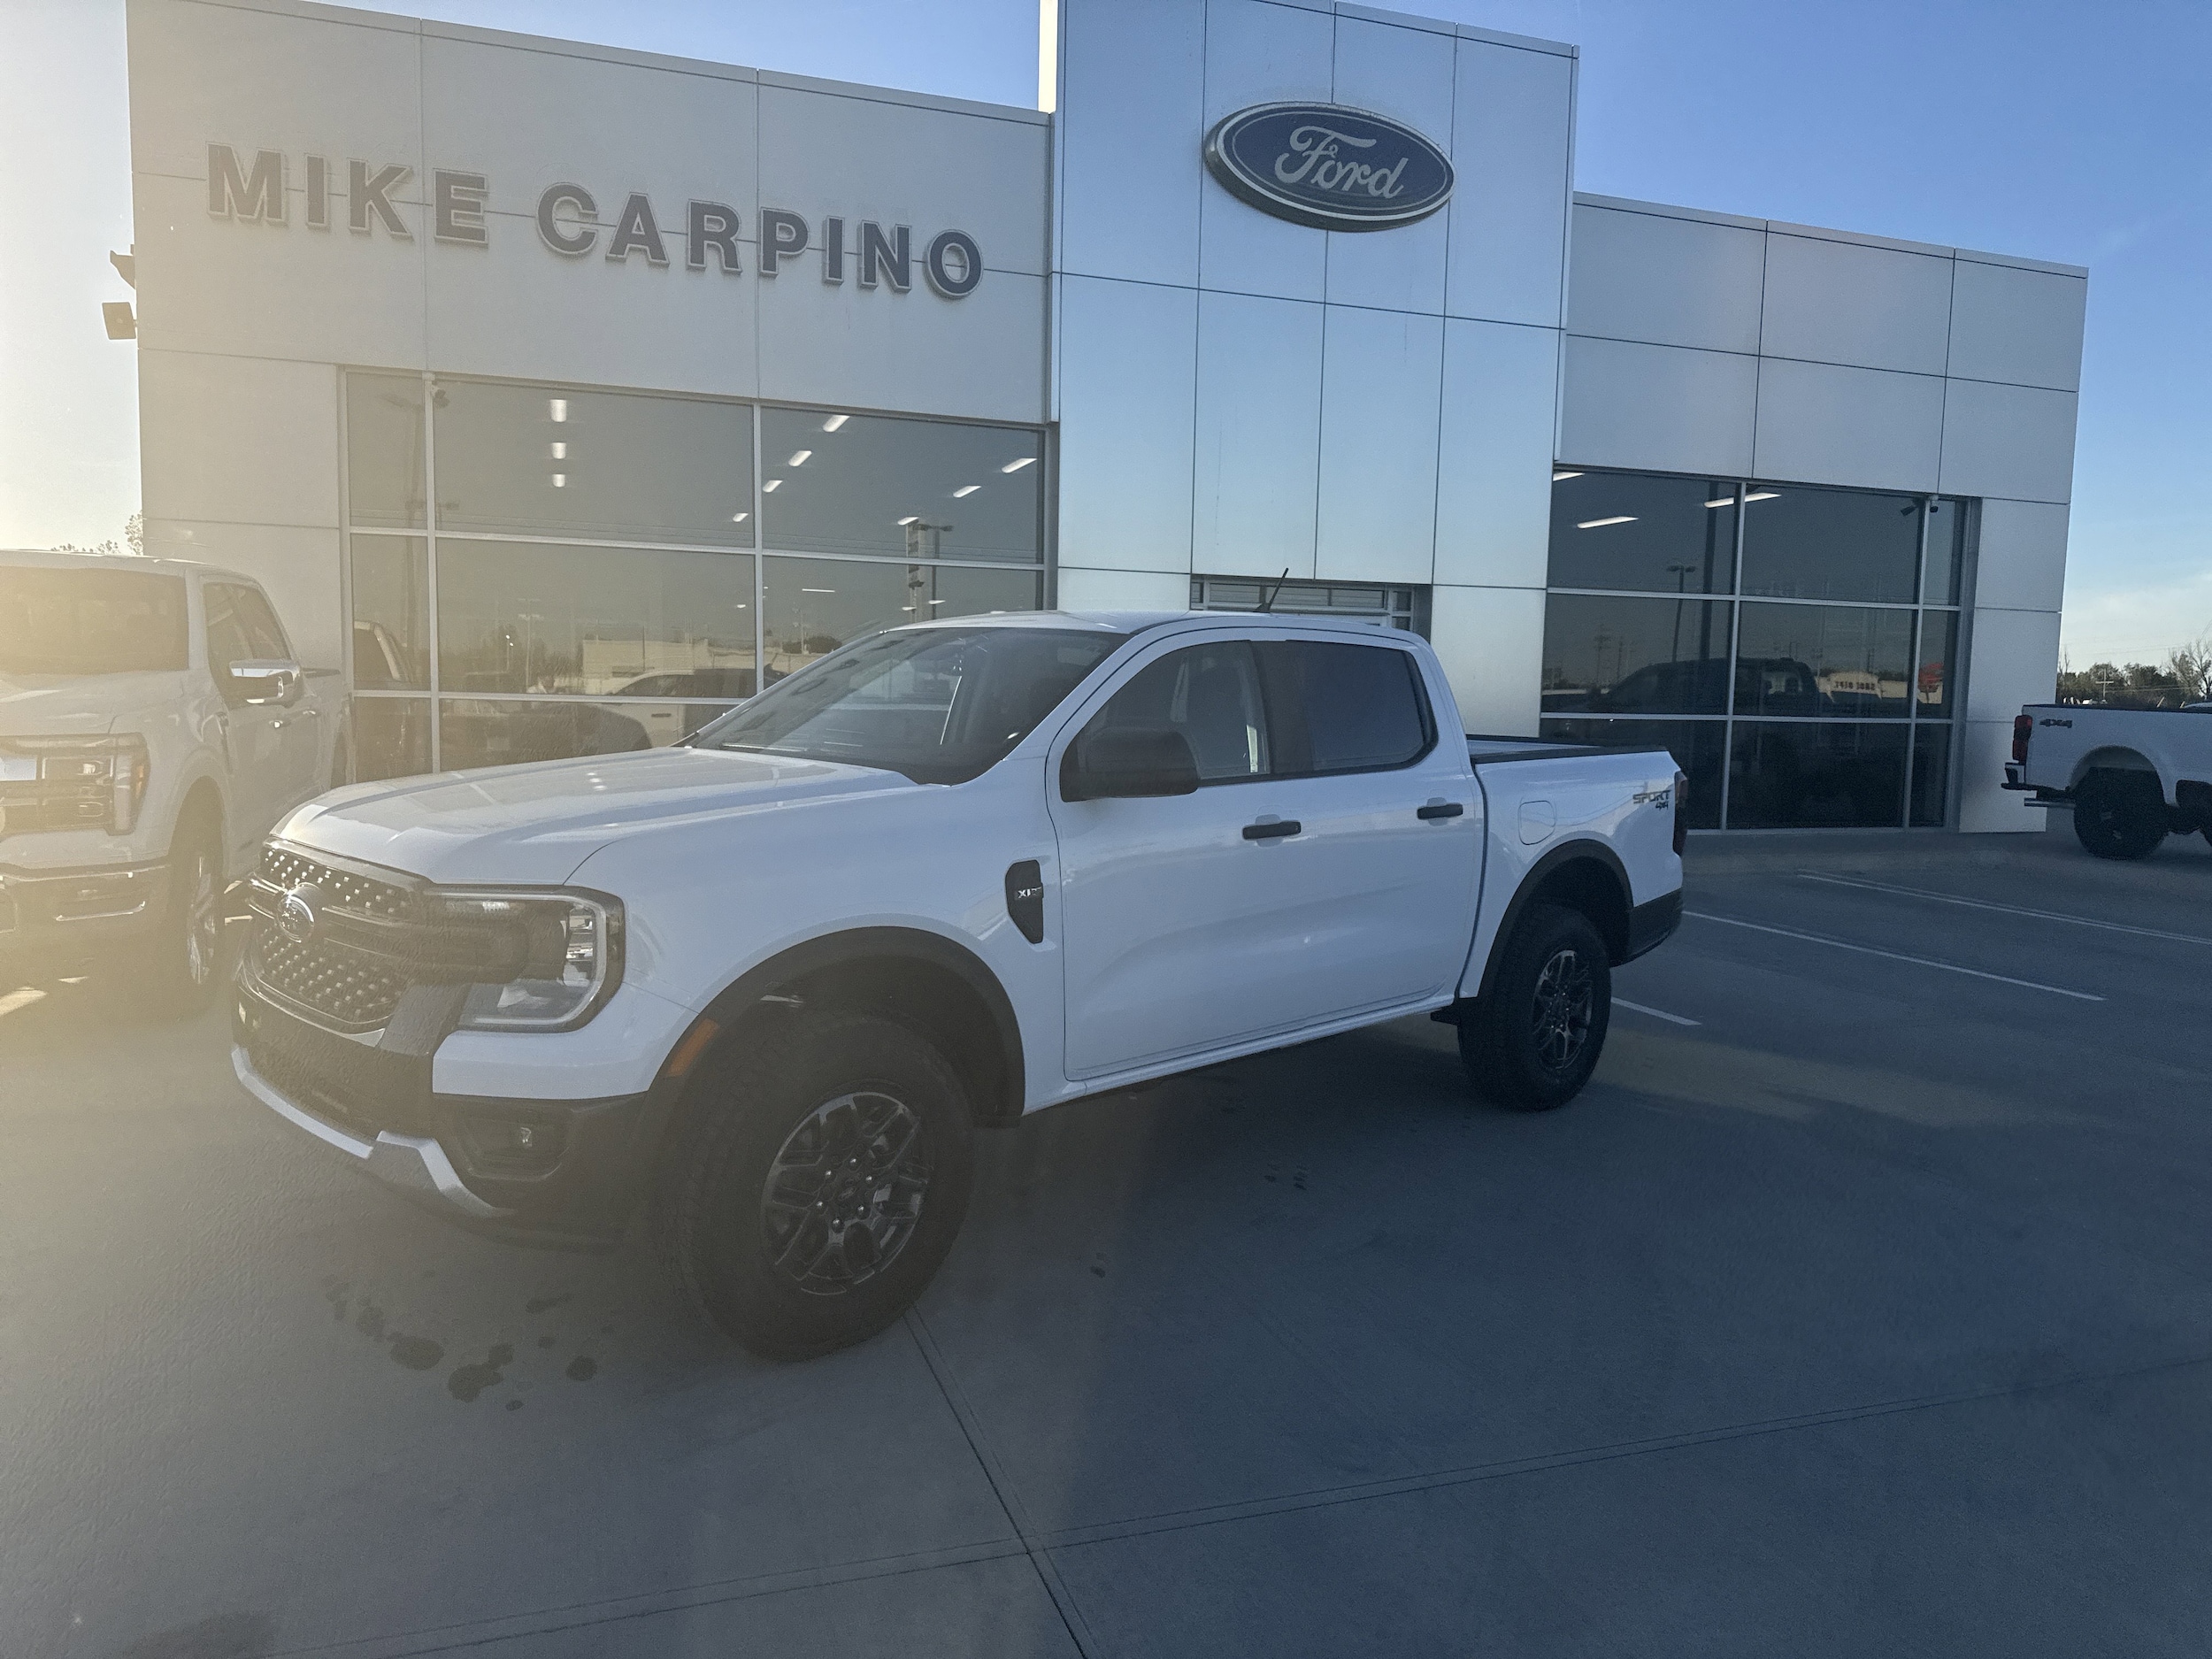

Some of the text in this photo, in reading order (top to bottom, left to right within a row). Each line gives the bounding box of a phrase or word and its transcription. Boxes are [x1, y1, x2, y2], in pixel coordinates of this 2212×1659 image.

[1274, 126, 1409, 198] Ford
[207, 142, 984, 300] MIKE CARPINO
